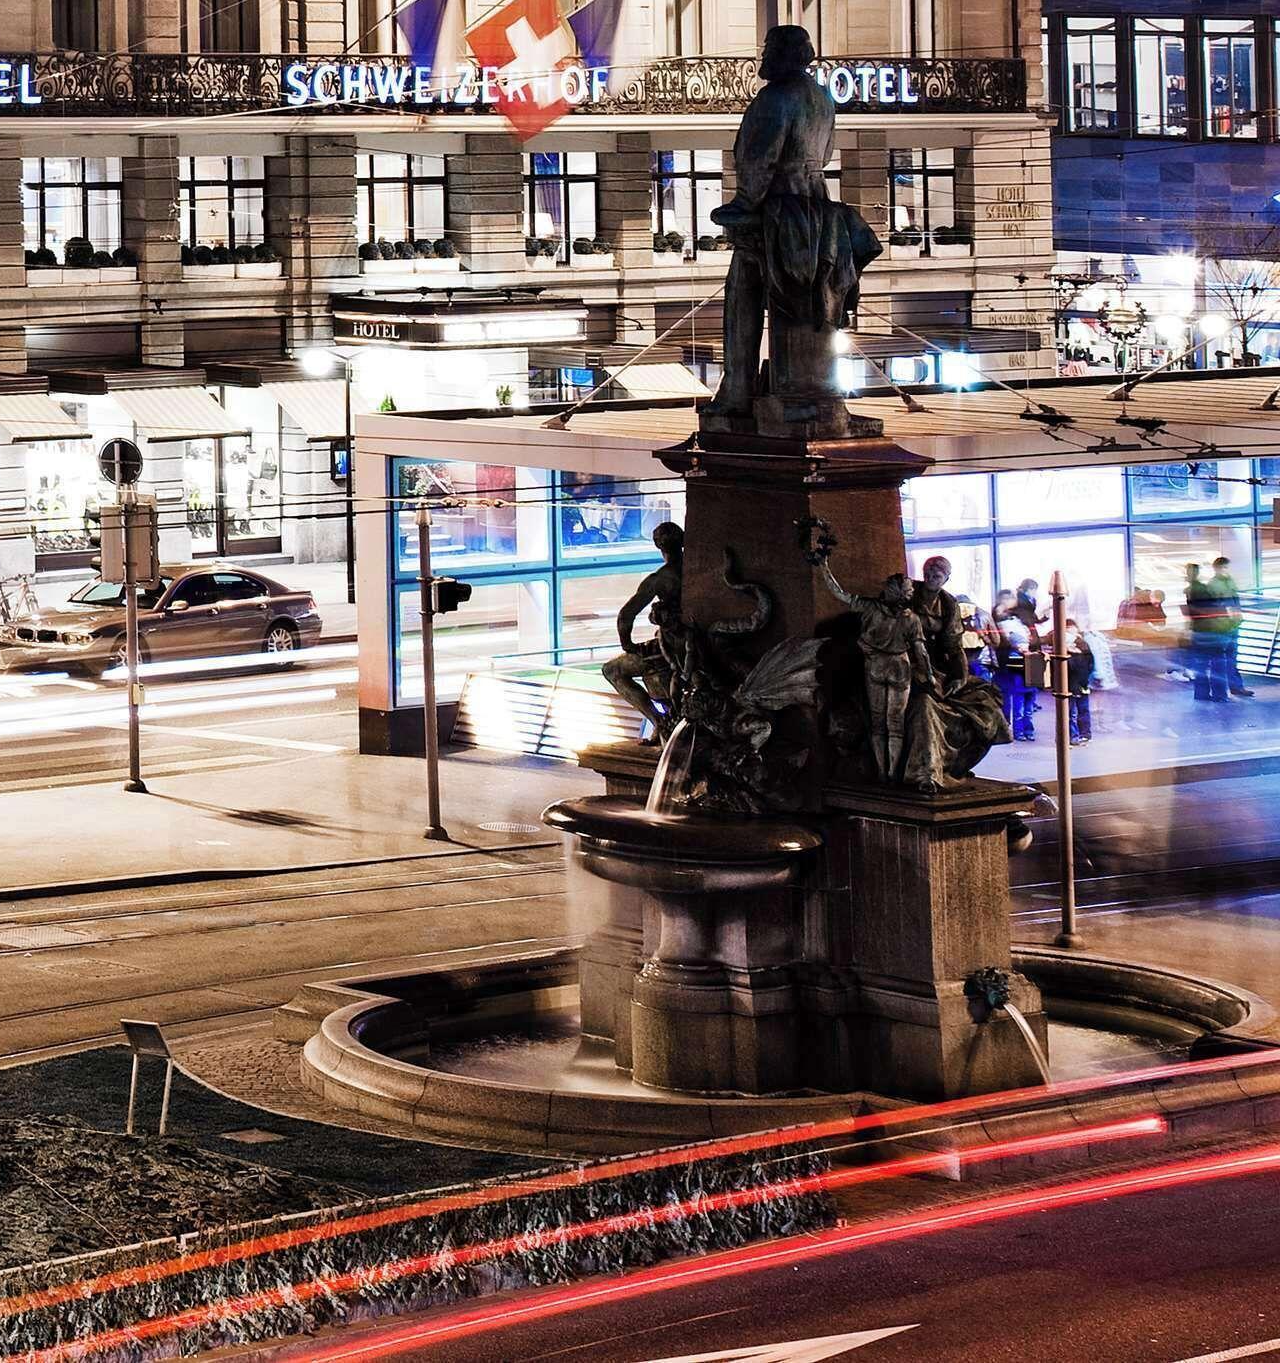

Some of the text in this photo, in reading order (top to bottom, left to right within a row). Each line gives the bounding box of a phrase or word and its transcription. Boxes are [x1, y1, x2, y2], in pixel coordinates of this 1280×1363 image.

[286, 64, 610, 106] SCHWEIZERHOF
[810, 65, 918, 104] OTEL
[353, 322, 400, 339] HOTEL
